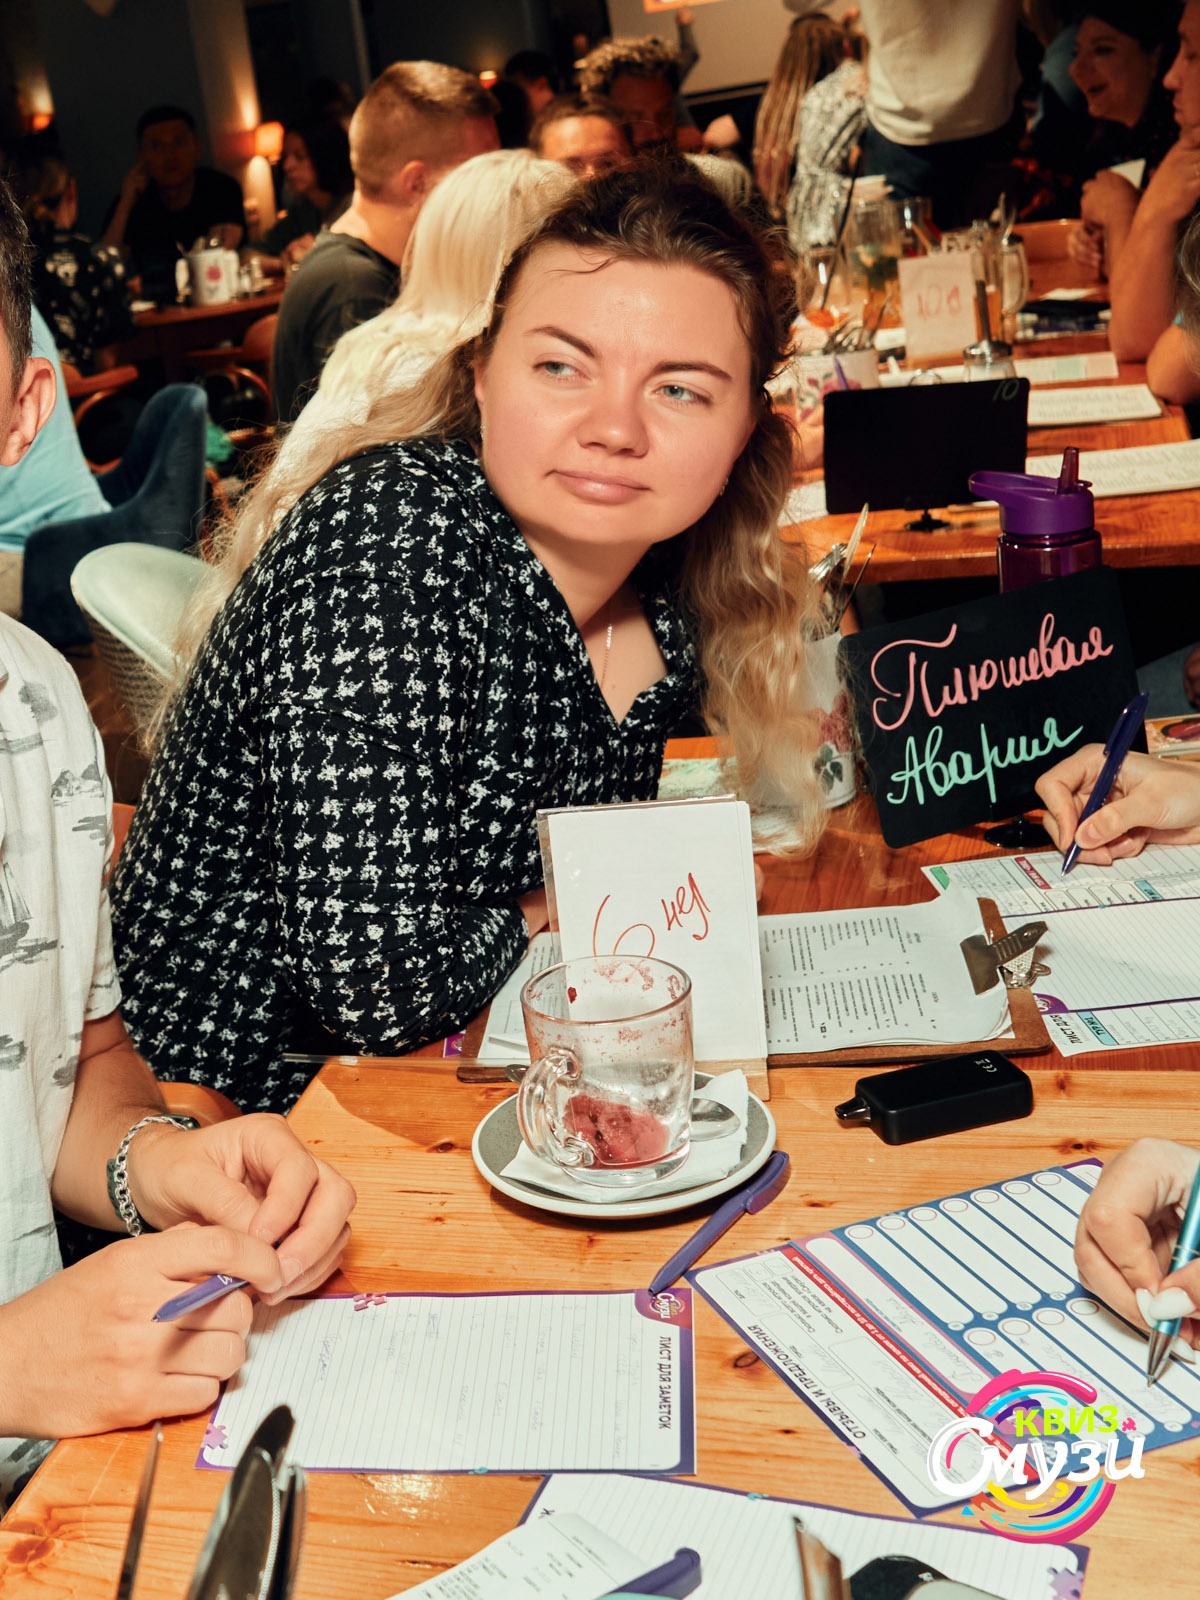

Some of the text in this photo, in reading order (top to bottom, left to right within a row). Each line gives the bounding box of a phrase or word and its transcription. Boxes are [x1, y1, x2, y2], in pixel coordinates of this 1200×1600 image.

[993, 378, 1020, 401] 10
[871, 613, 1114, 730] Плюшевая
[887, 717, 1084, 805] Авария
[661, 872, 712, 941] чел
[1060, 1027, 1083, 1044] ЛИСТ
[657, 1336, 672, 1430] ЛИСТ ДЛЯ ЗАМЕТОК
[746, 1323, 868, 1439] ОТЗЫВЫ И ПРЕДЛОЖЕНИЯ
